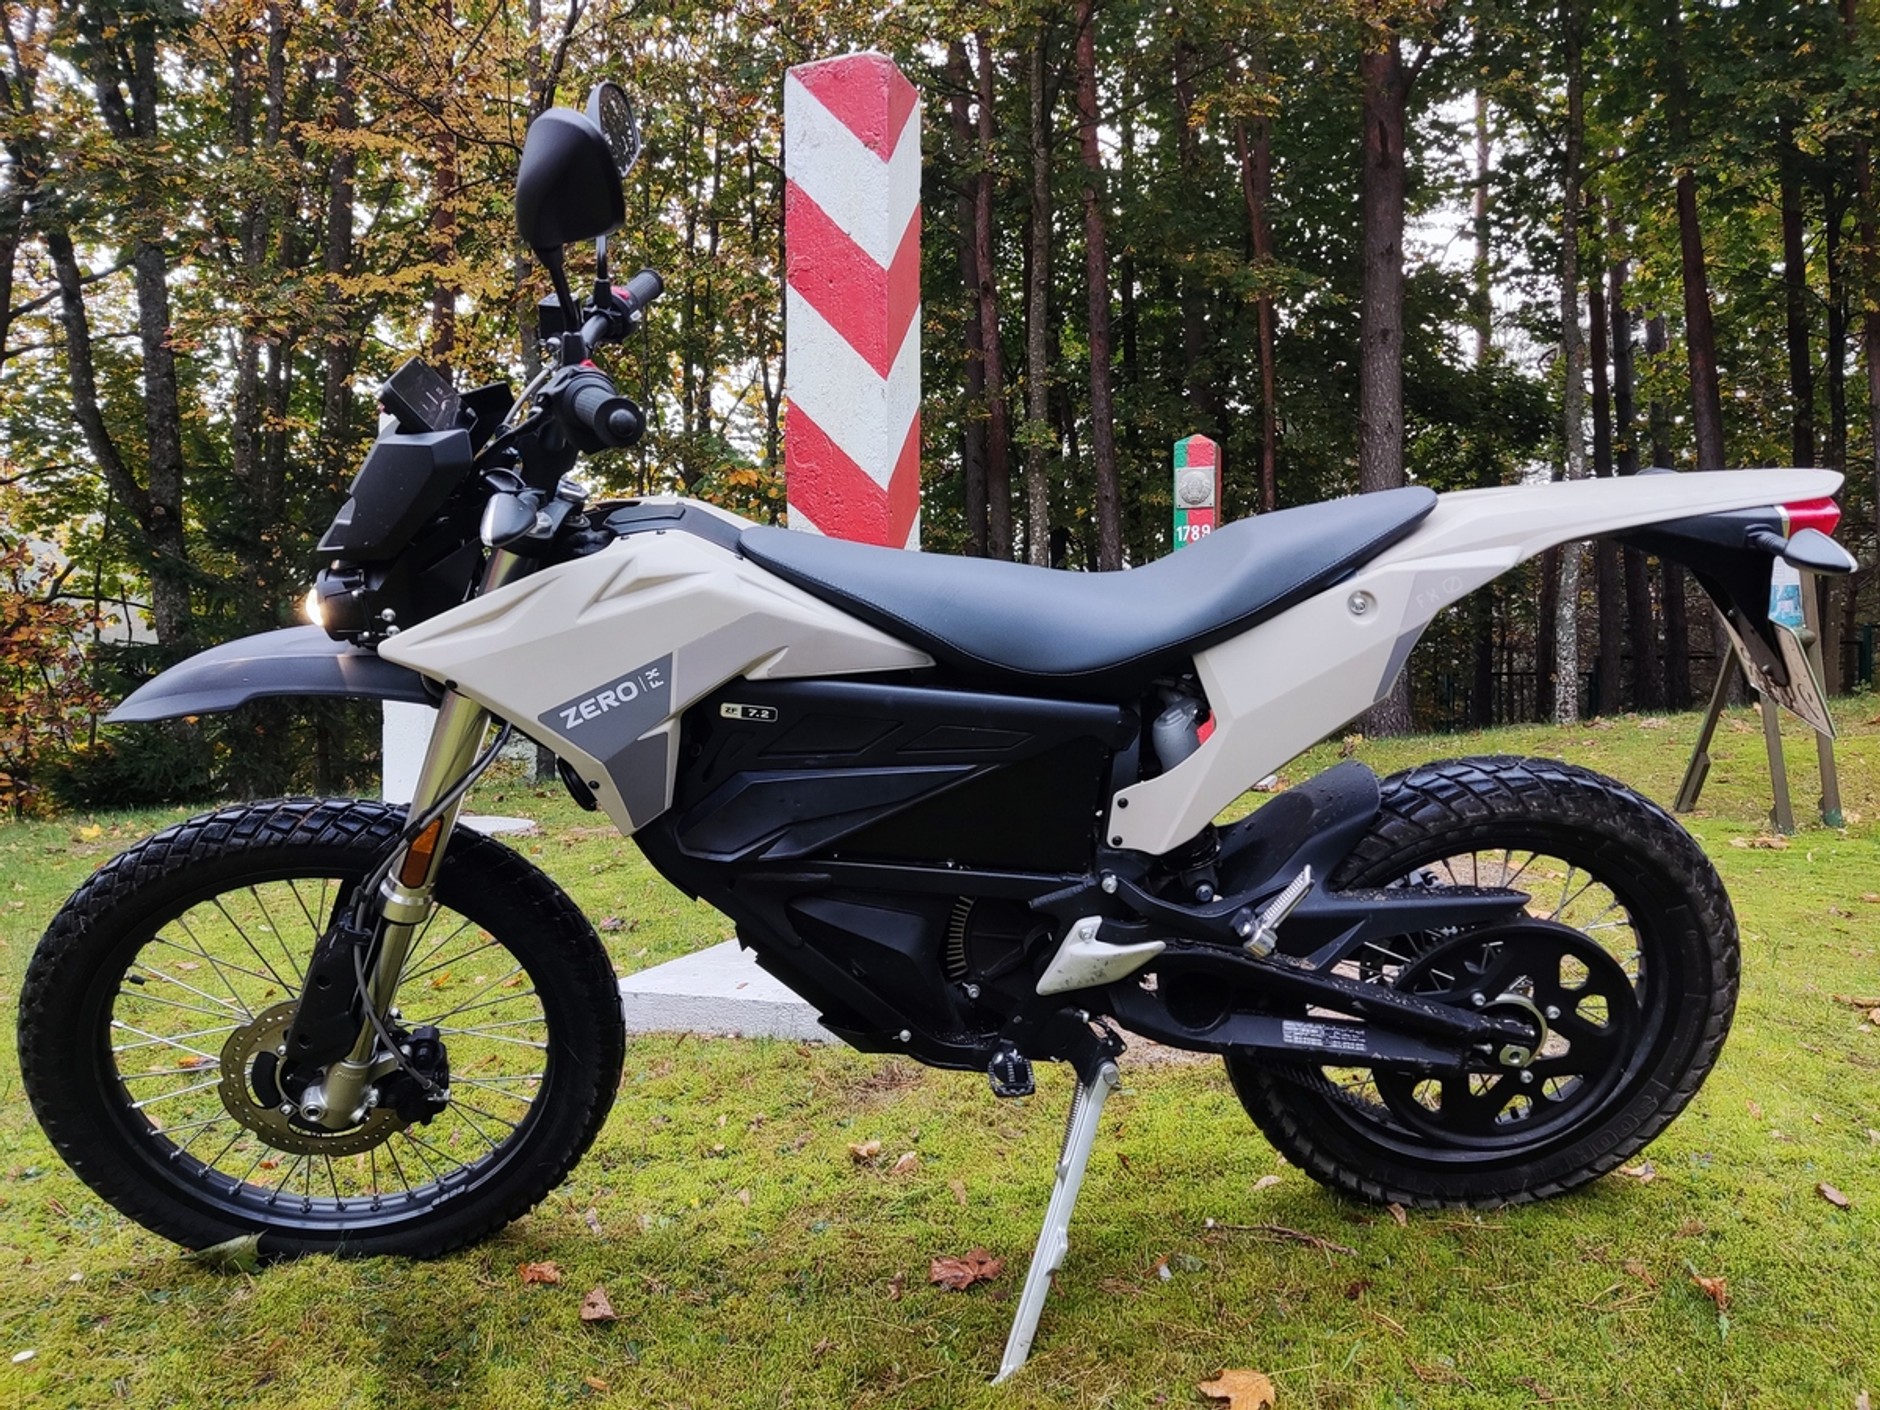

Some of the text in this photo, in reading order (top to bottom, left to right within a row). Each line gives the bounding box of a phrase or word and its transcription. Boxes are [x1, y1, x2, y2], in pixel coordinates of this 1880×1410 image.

[1176, 524, 1211, 542] 1789
[560, 667, 664, 730] ZERO FX
[724, 706, 770, 719] ZF 7.2
